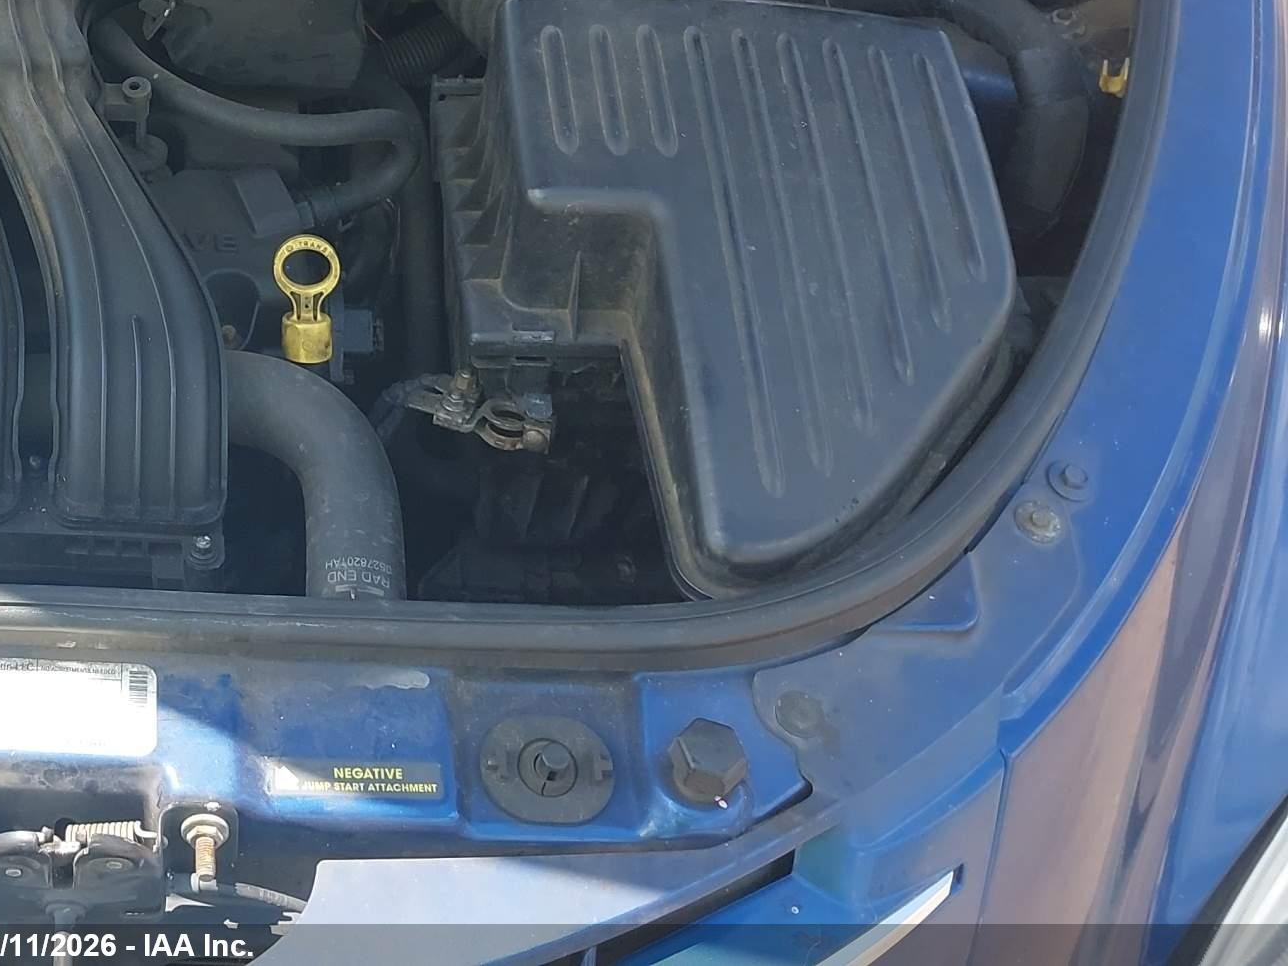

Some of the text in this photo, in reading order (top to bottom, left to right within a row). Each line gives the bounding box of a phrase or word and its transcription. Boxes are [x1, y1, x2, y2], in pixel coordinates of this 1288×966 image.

[298, 240, 329, 253] TRANS
[327, 569, 391, 589] RAD END
[333, 767, 403, 780] NEGATIVE
[302, 781, 438, 793] JUMP START ATTACHMENT
